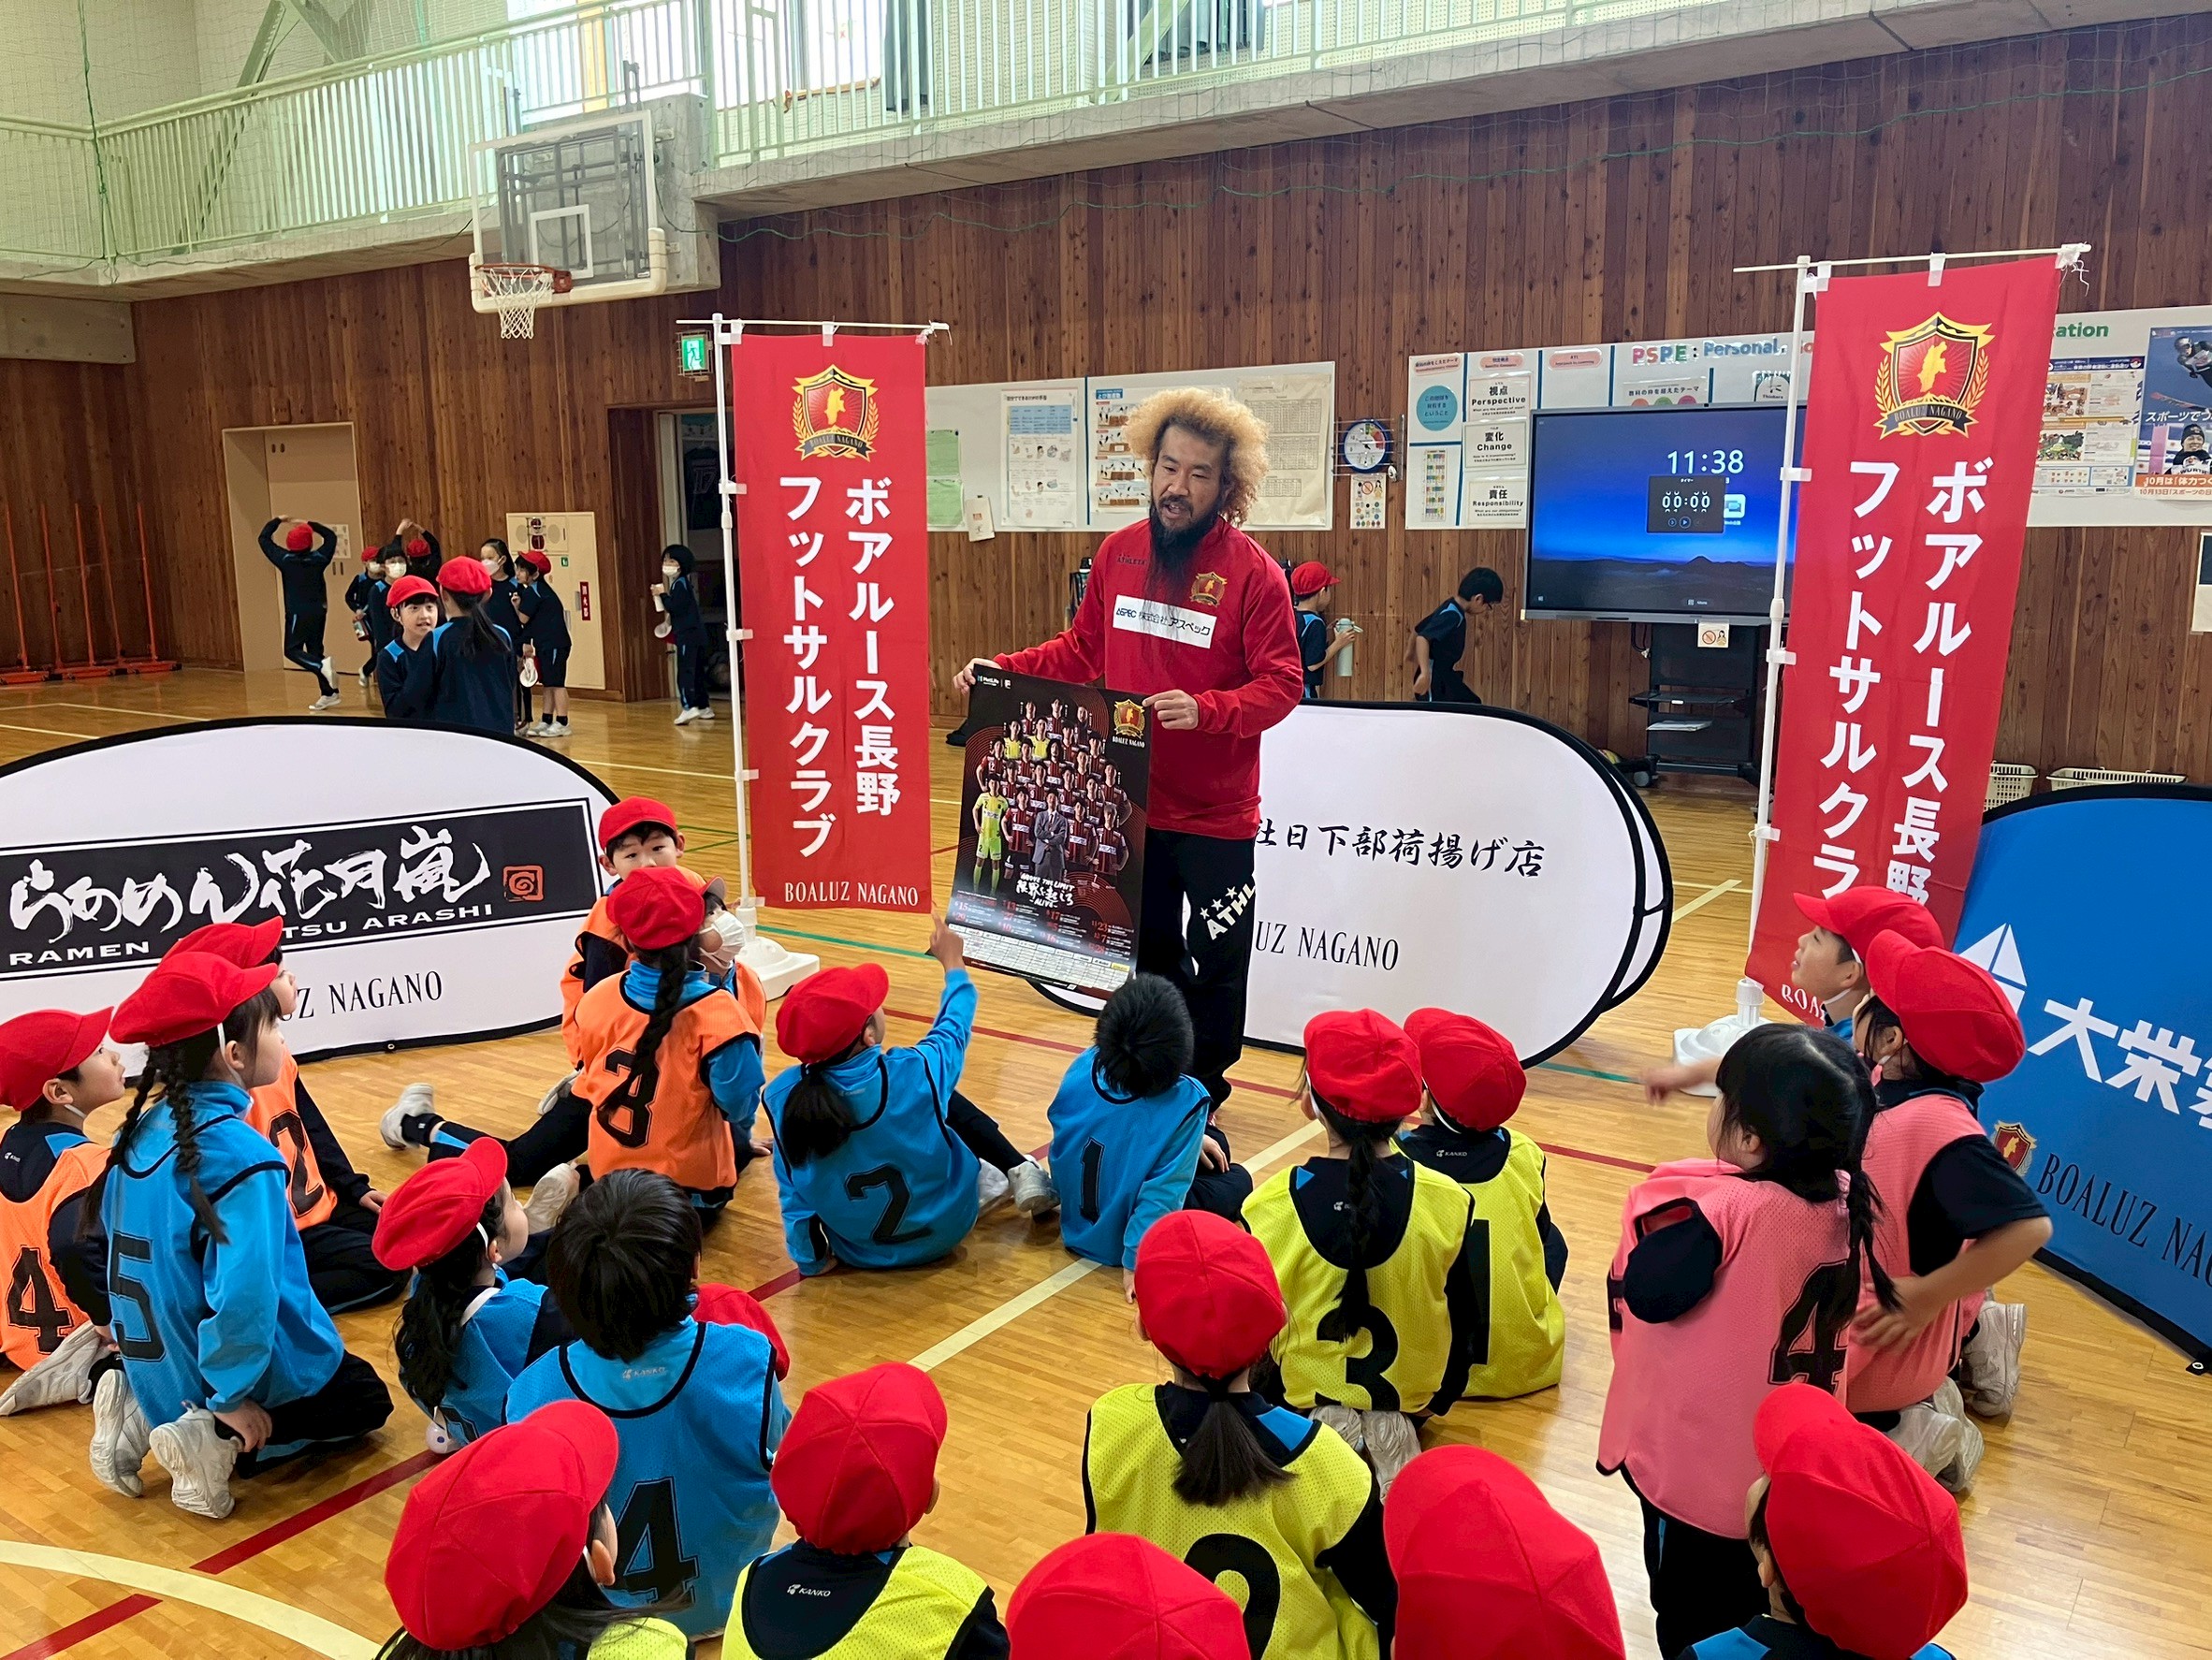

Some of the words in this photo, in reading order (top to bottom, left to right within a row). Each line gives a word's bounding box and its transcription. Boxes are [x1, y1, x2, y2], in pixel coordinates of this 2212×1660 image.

[1471, 396, 1526, 406] Perspective
[1489, 386, 1508, 396] 視点
[1929, 405, 1964, 419] NAGANO
[1477, 443, 1512, 451] Change
[1485, 431, 1505, 442] 変化
[1667, 449, 1744, 474] 11:38
[1489, 489, 1508, 499] 責任
[1662, 495, 1710, 508] 00:00
[845, 477, 900, 816] ボアルース長野
[779, 477, 837, 857] フットサルクラブ
[784, 881, 850, 903] BOALUZ
[857, 882, 919, 907] NAGANO
[1054, 881, 1075, 892] LIMIT
[959, 902, 968, 910] 15
[1051, 910, 1060, 921] 17
[9, 940, 150, 967] RAMEN
[362, 903, 492, 930] ARASHI
[1098, 922, 1108, 932] 23
[1297, 926, 1400, 971] NAGANO
[328, 970, 443, 1014] NAGANO
[269, 1110, 327, 1217] 2
[1080, 1136, 1105, 1226] 1
[845, 1163, 933, 1245] 2
[2036, 1152, 2158, 1248] BOALUZ
[7, 1245, 74, 1356] 4
[108, 1230, 167, 1363] 5
[1768, 1258, 1848, 1396] 4
[1315, 1304, 1402, 1412] 3
[604, 1477, 700, 1606] 4
[798, 1587, 832, 1598] KANKO
